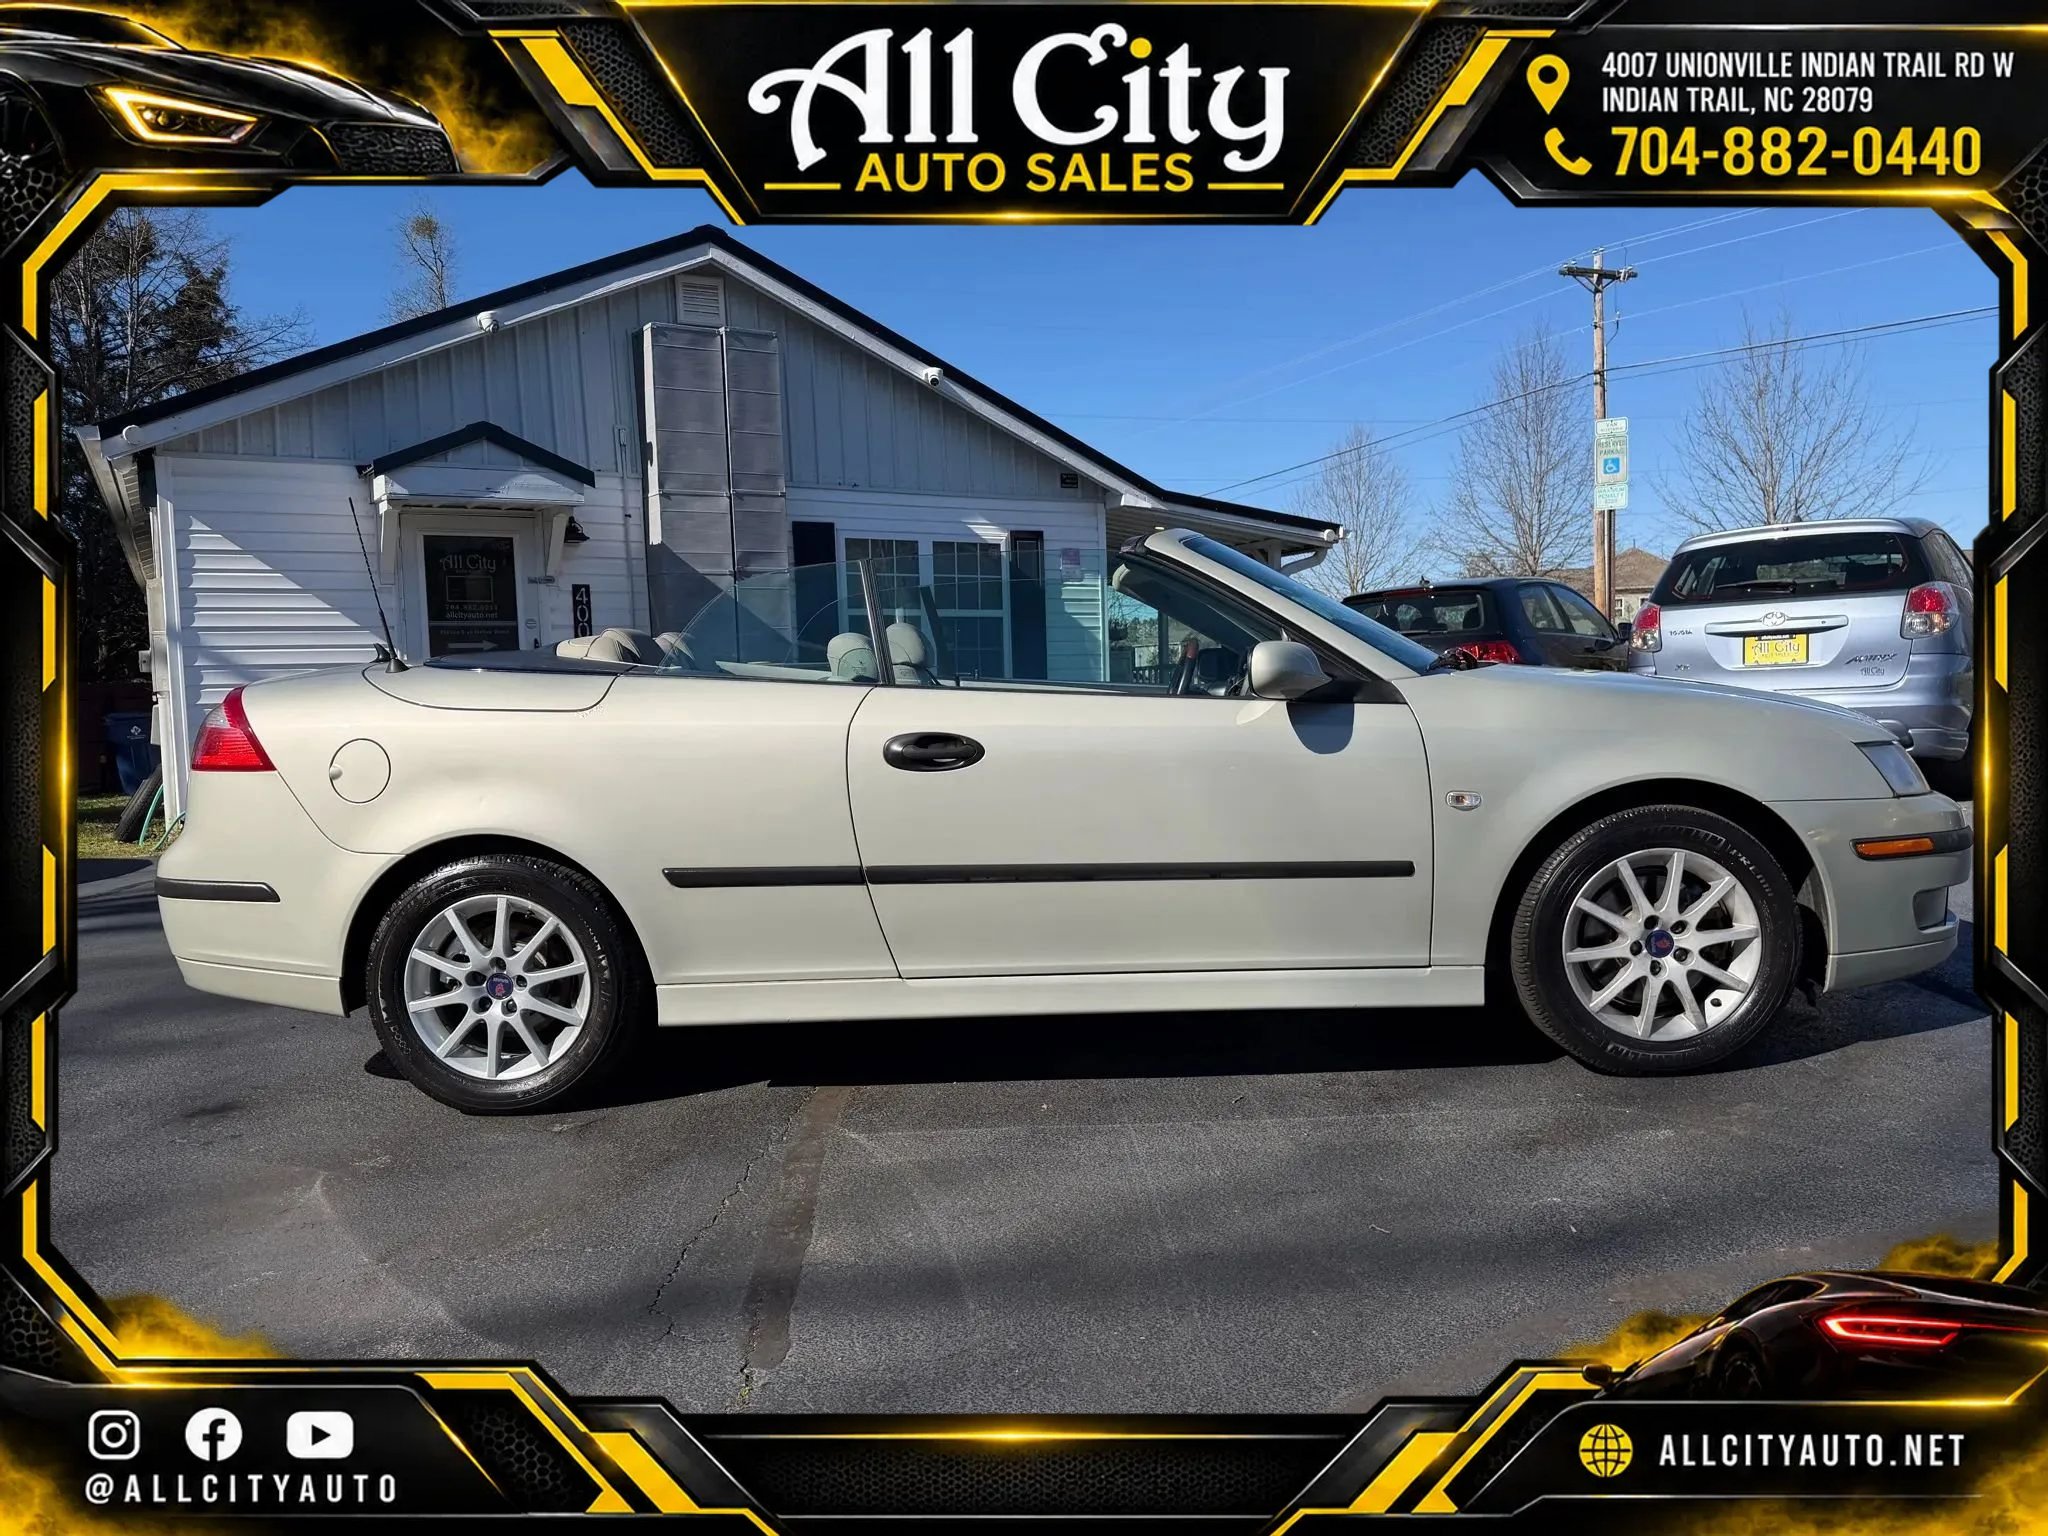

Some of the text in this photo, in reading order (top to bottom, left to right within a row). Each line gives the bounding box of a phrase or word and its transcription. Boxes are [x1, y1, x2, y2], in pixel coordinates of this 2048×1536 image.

[440, 553, 496, 573] All City
[1752, 640, 1800, 656] All City
